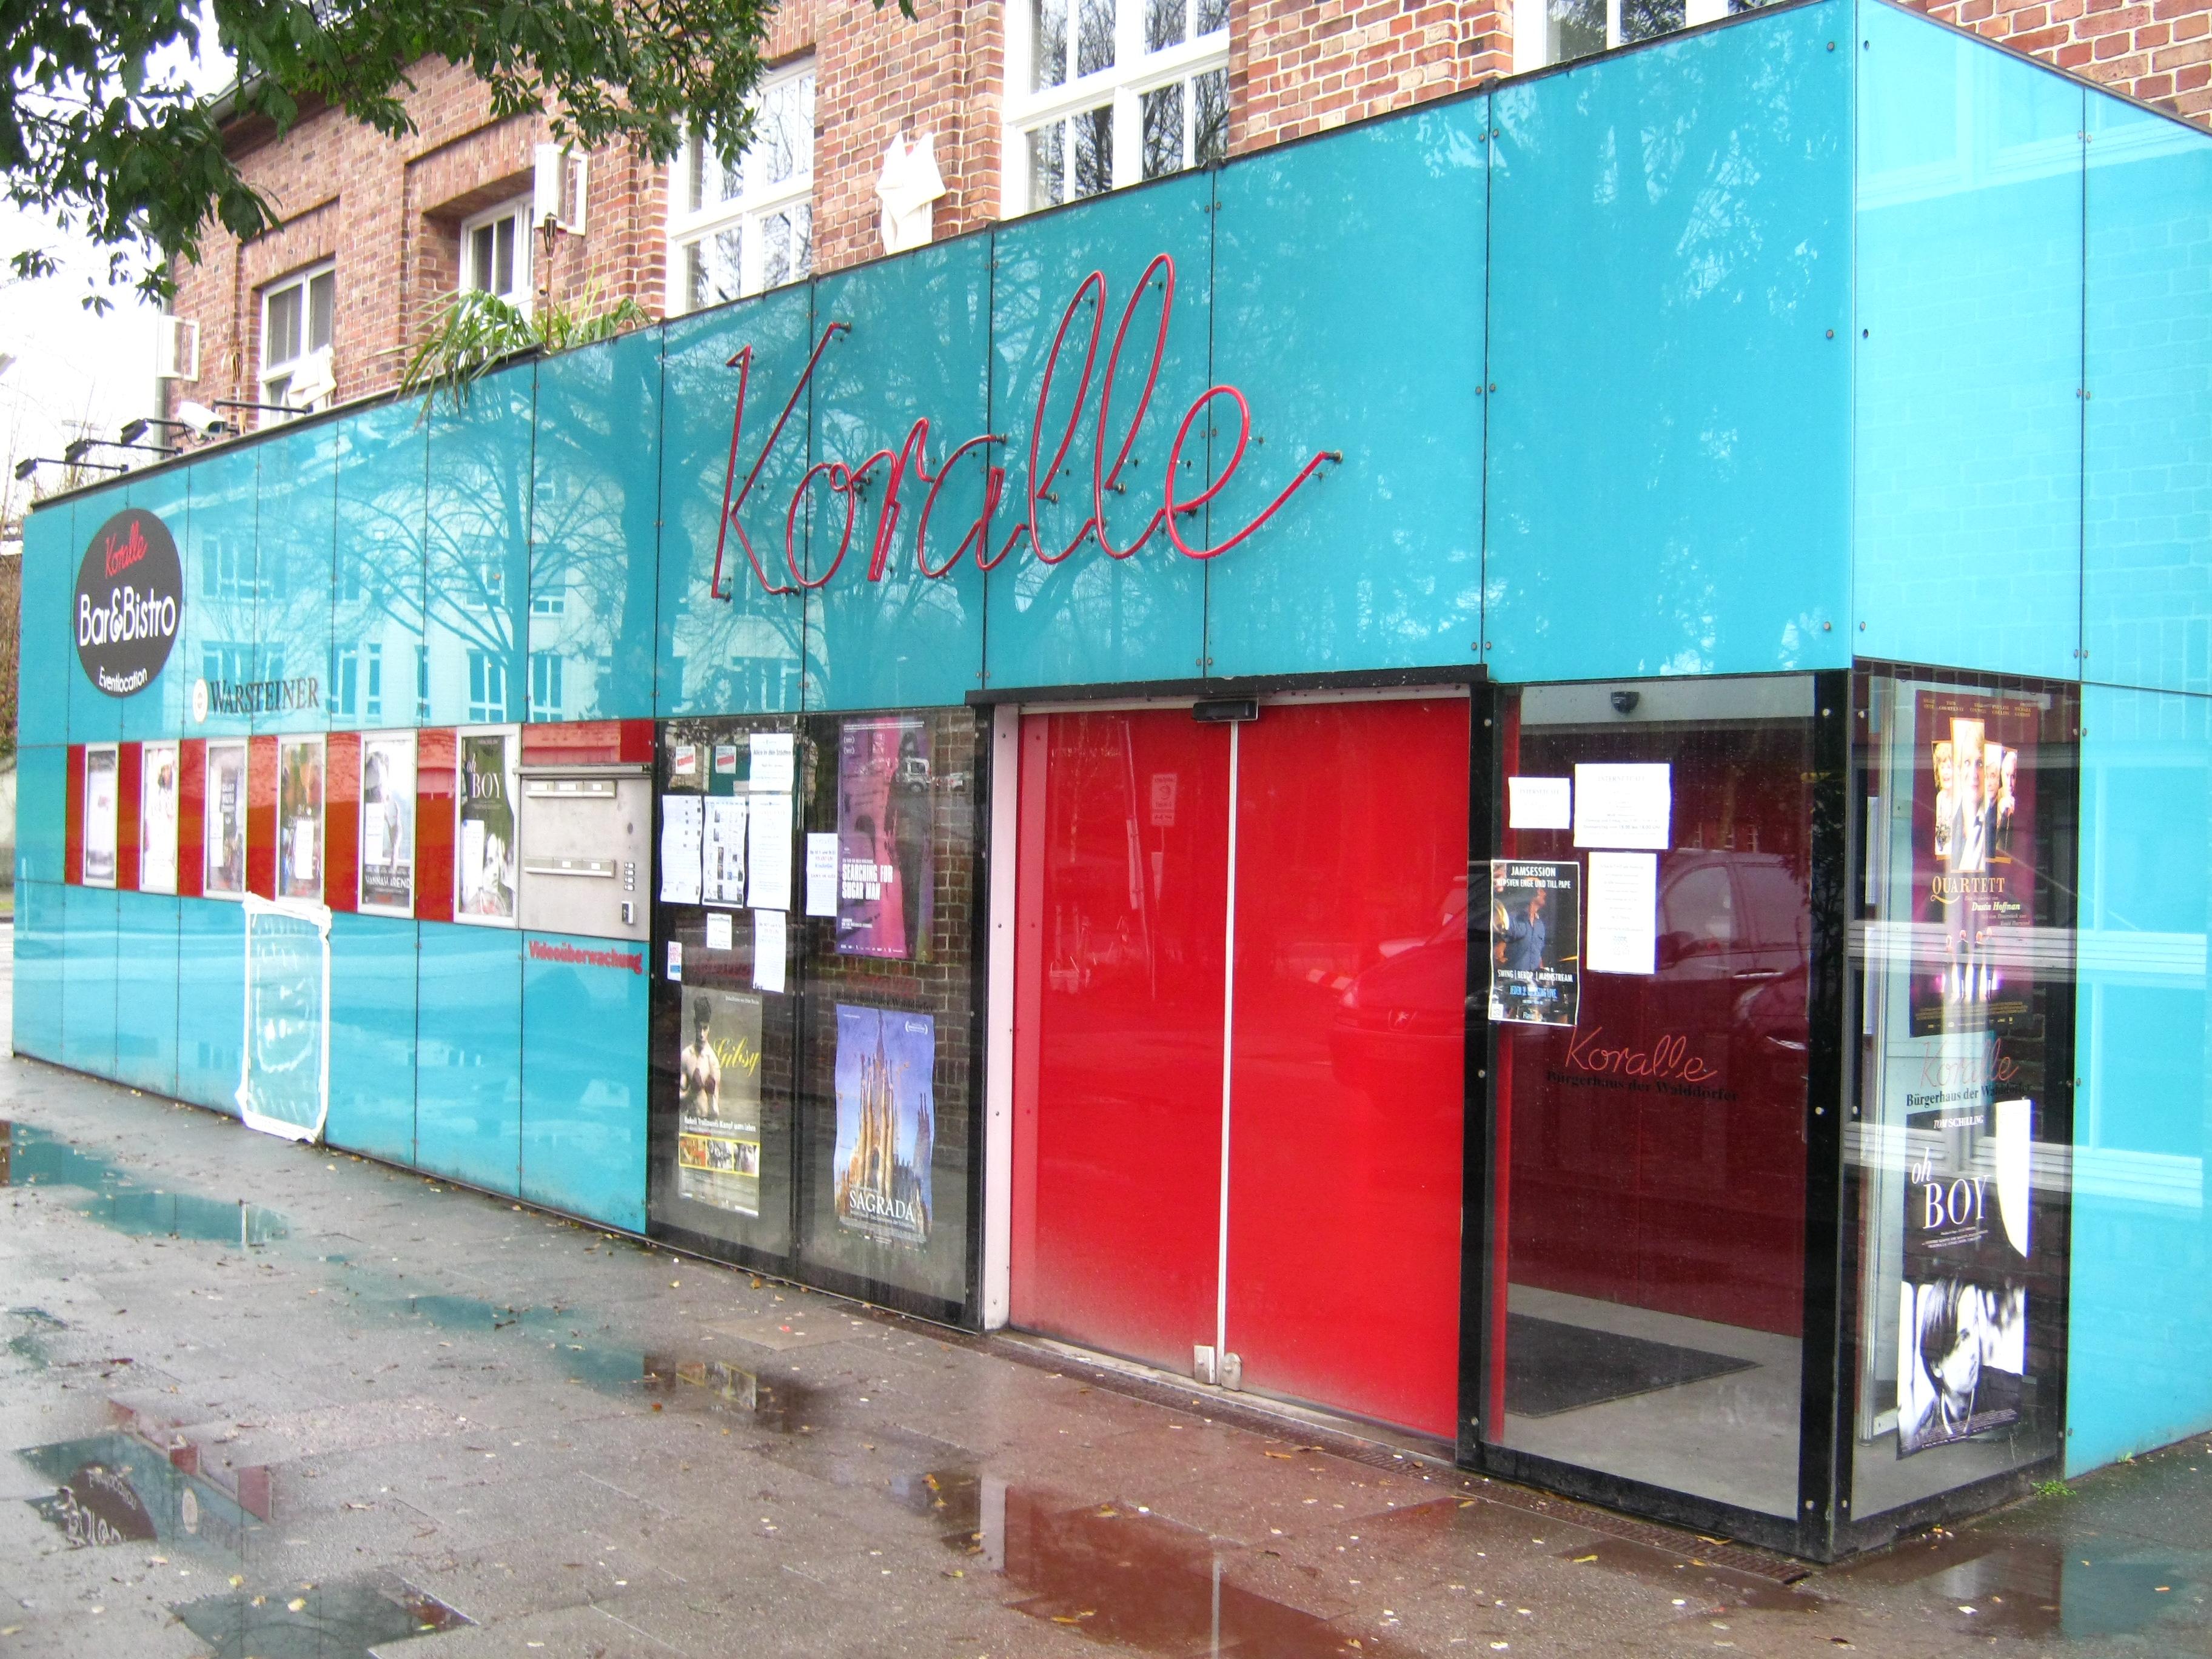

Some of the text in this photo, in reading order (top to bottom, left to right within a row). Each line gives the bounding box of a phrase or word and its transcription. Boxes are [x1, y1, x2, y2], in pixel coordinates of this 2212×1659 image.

[711, 253, 1341, 600] Koralle
[106, 520, 148, 579] Koralle
[79, 585, 176, 647] Bar&Bistro
[99, 665, 147, 692] Eventlocation
[210, 677, 319, 715] WARSTEINER
[466, 752, 477, 773] oh
[472, 773, 501, 799] BOY
[365, 875, 389, 886] HANNAH
[842, 863, 893, 883] SEARCHING FOR
[1510, 866, 1556, 877] JAMSESSION
[1547, 880, 1558, 888] TILL
[1558, 880, 1571, 889] PAPE
[842, 882, 880, 900] SUGAR MAN
[1930, 876, 2005, 905] QUARTETT
[1972, 901, 2020, 913] Dustin Hoffman
[529, 940, 643, 975] Videoüberwachung
[1498, 969, 1513, 979] SWING
[1565, 1025, 1718, 1082] Koralle
[1920, 1037, 2019, 1088] Koralle
[1547, 1070, 1624, 1090] Bürgerhaus
[1628, 1078, 1651, 1091] der
[1906, 1091, 1961, 1108] Bürgerhaus
[1963, 1088, 1979, 1100] der
[1934, 1114, 1984, 1129] TOM SCHILLING
[1911, 1146, 1932, 1188] oh
[850, 1190, 916, 1224] SAGRADA
[1923, 1174, 1991, 1230] BOY
